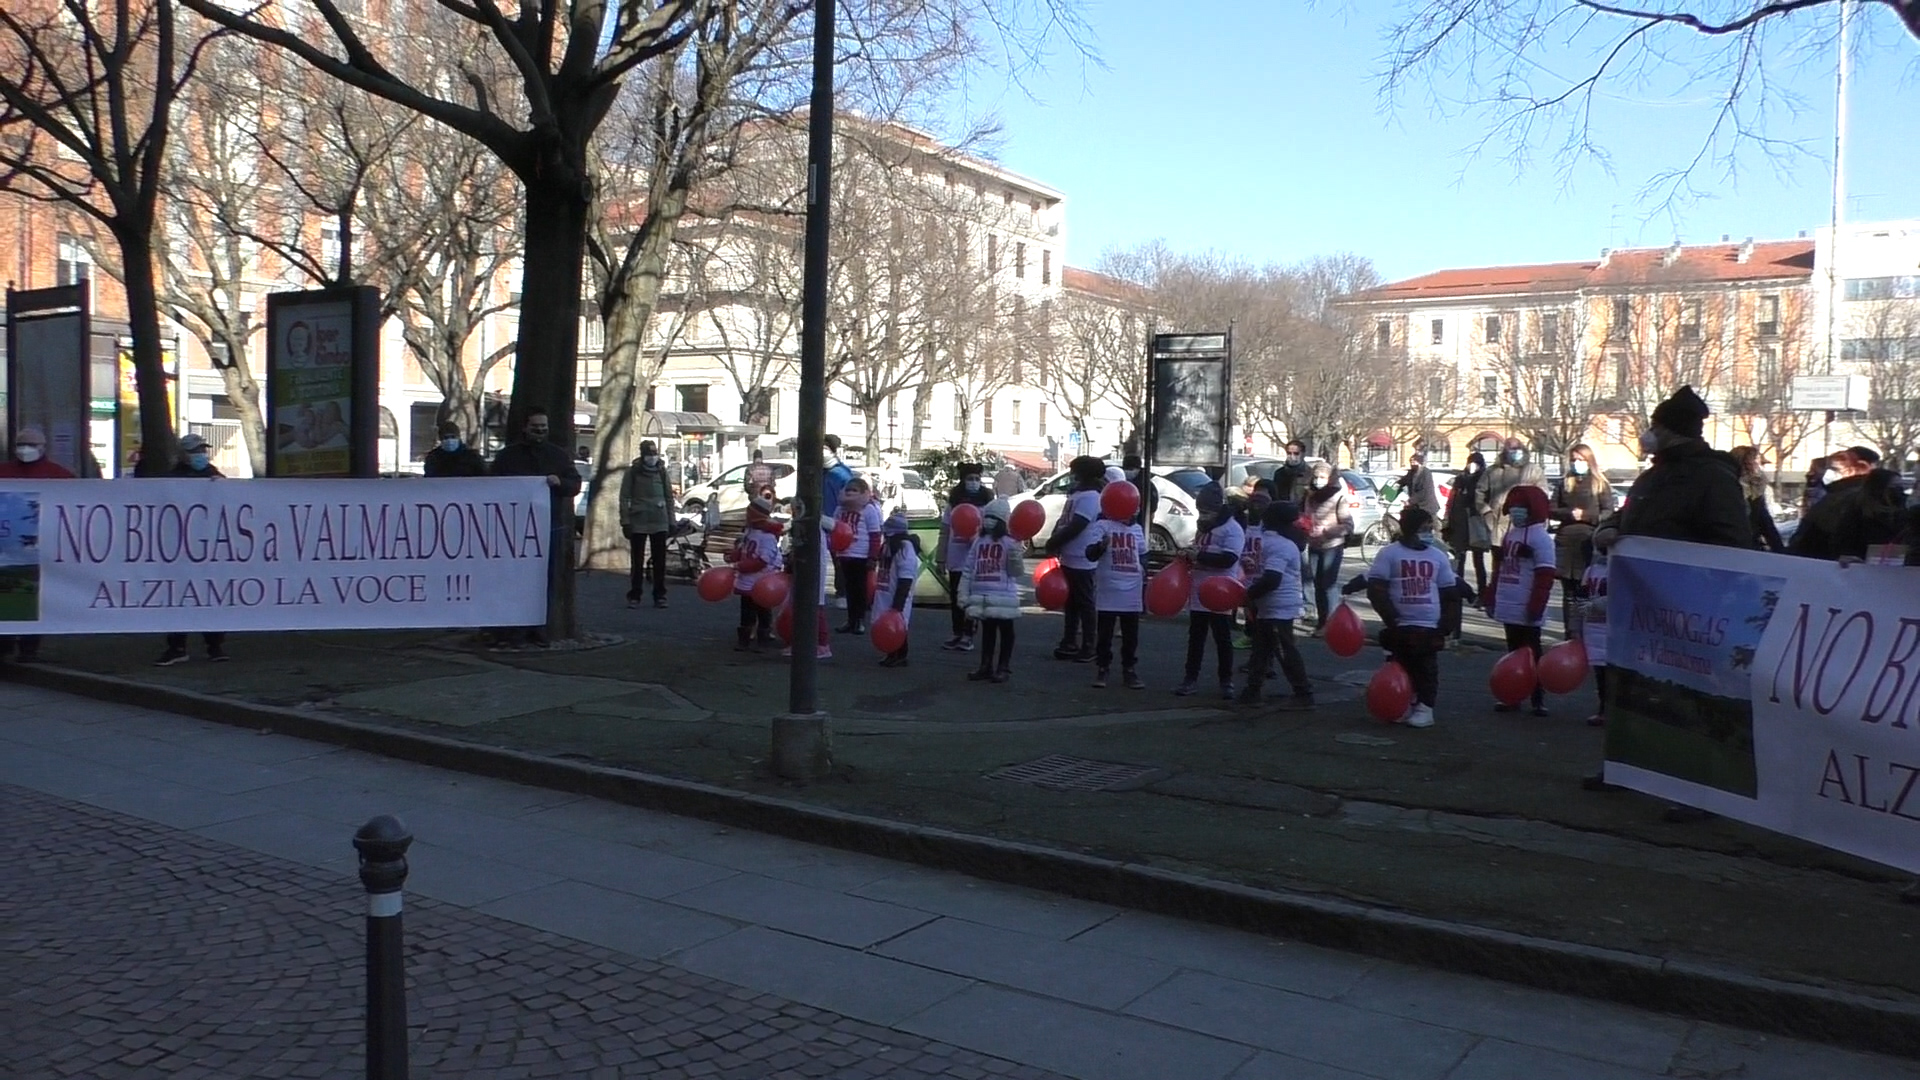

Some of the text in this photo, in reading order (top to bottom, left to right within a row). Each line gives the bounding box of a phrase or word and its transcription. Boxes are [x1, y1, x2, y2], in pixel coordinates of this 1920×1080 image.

[54, 503, 543, 563] NO BIOGAS a VALMADONNA
[978, 543, 1003, 559] NO
[1401, 559, 1434, 578] NO
[89, 573, 471, 609] ALZIAMO LA VOCE !!!
[1769, 603, 1874, 716] NO
